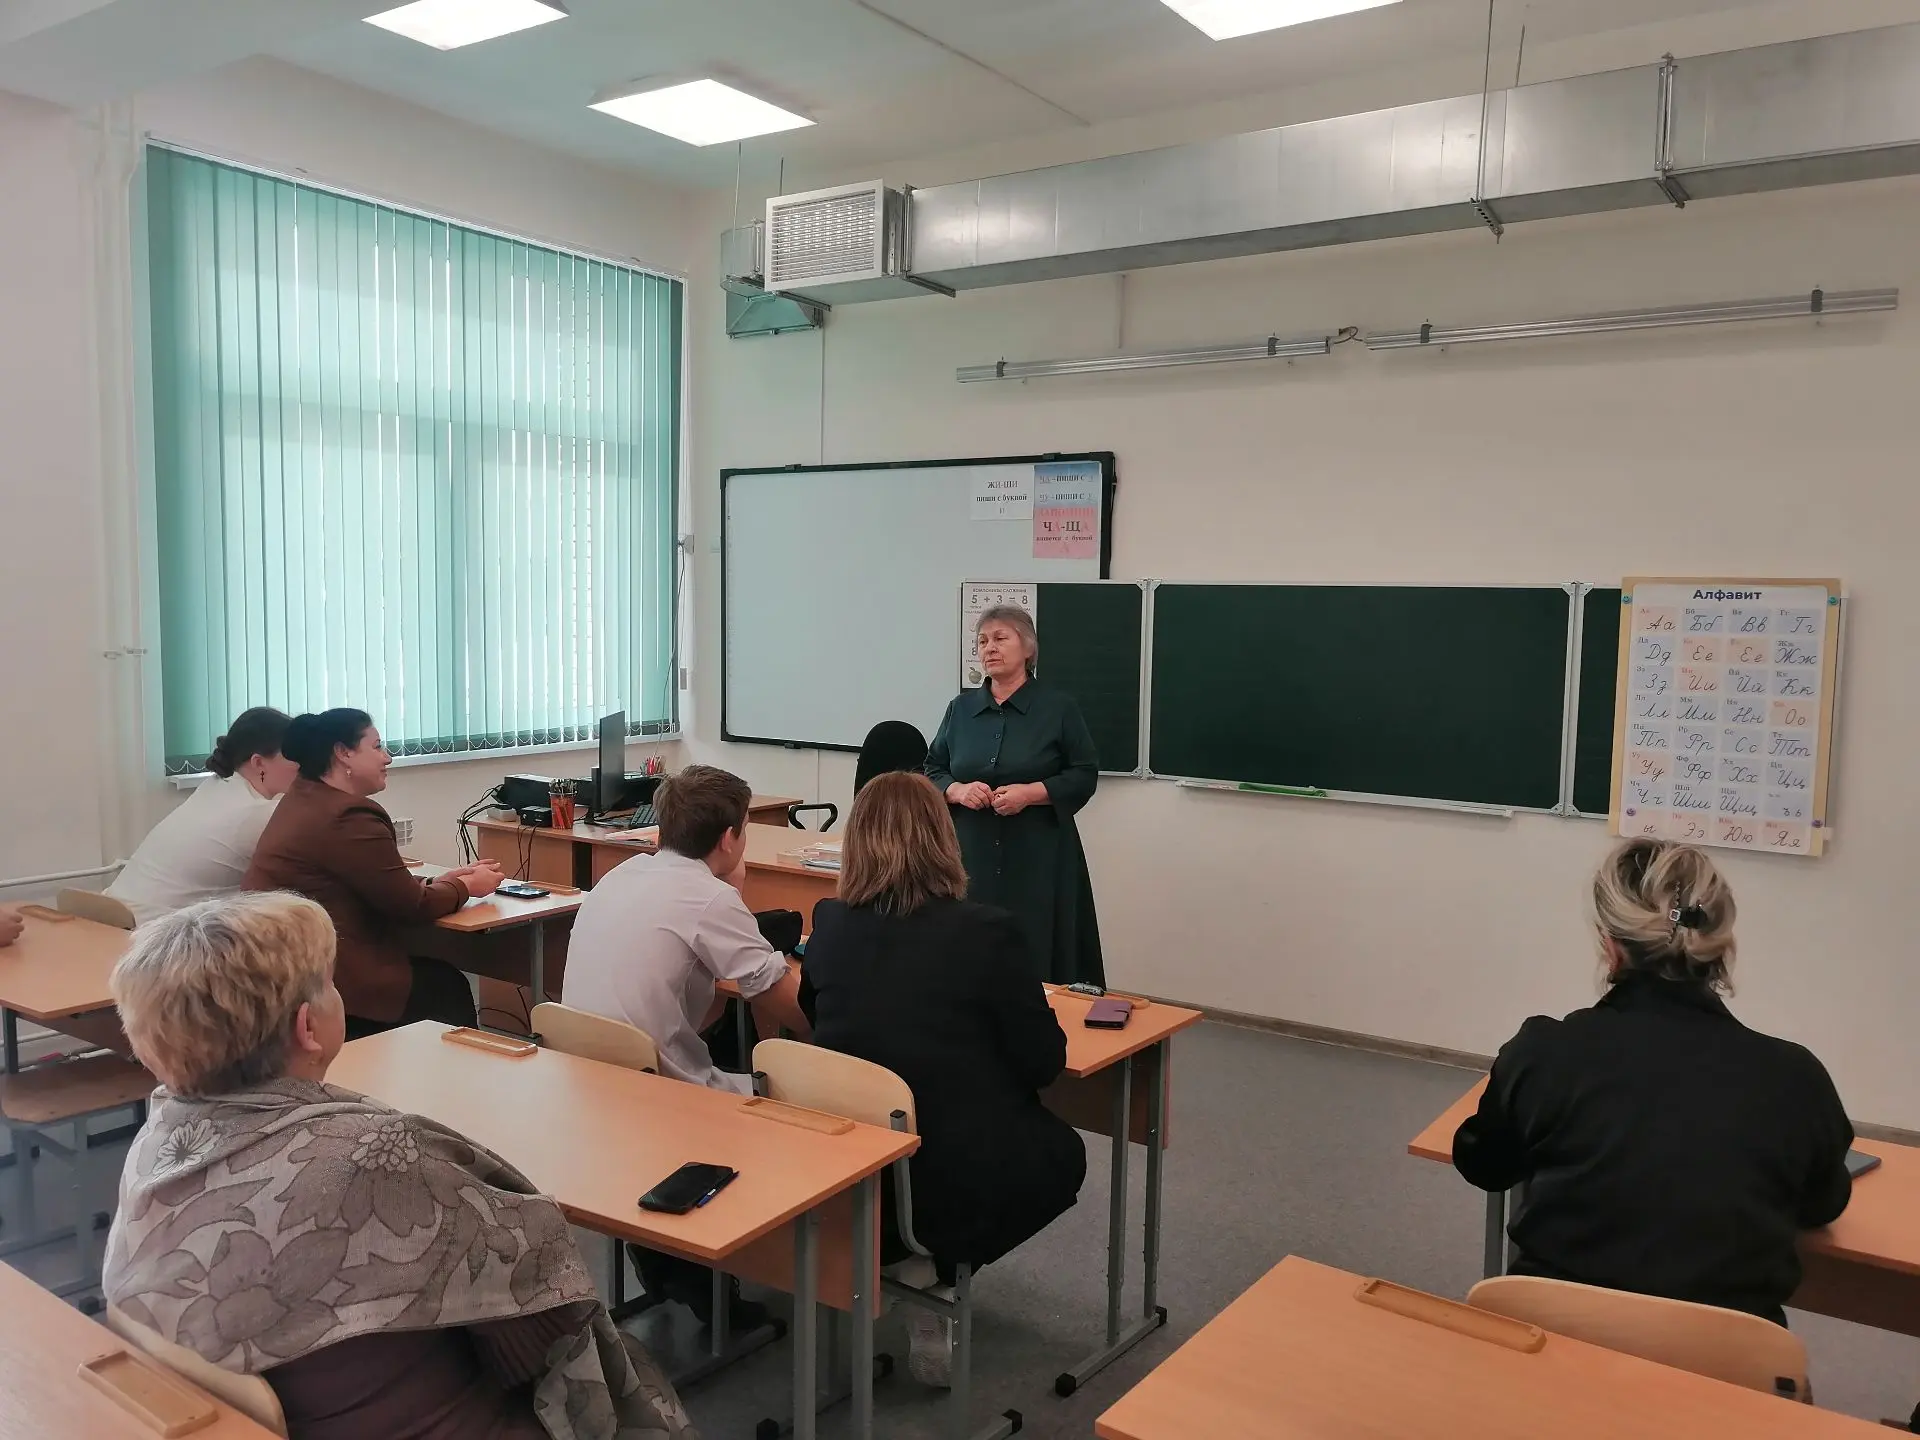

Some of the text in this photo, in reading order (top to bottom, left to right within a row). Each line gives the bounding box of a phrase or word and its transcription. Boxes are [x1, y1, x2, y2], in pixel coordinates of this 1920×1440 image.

[987, 480, 1018, 489] ЖИ-ШИ
[971, 594, 978, 604] 5
[996, 594, 1003, 604] 3
[1021, 595, 1028, 605] 8
[1693, 589, 1762, 601] Алфавит
[1646, 615, 1676, 631] Аа
[1690, 615, 1723, 631] Бб
[1741, 616, 1768, 632] Вв
[1774, 647, 1817, 665] Жж
[1784, 708, 1807, 726] Оо
[1728, 766, 1759, 784] Хх
[1723, 826, 1753, 843] Юю
